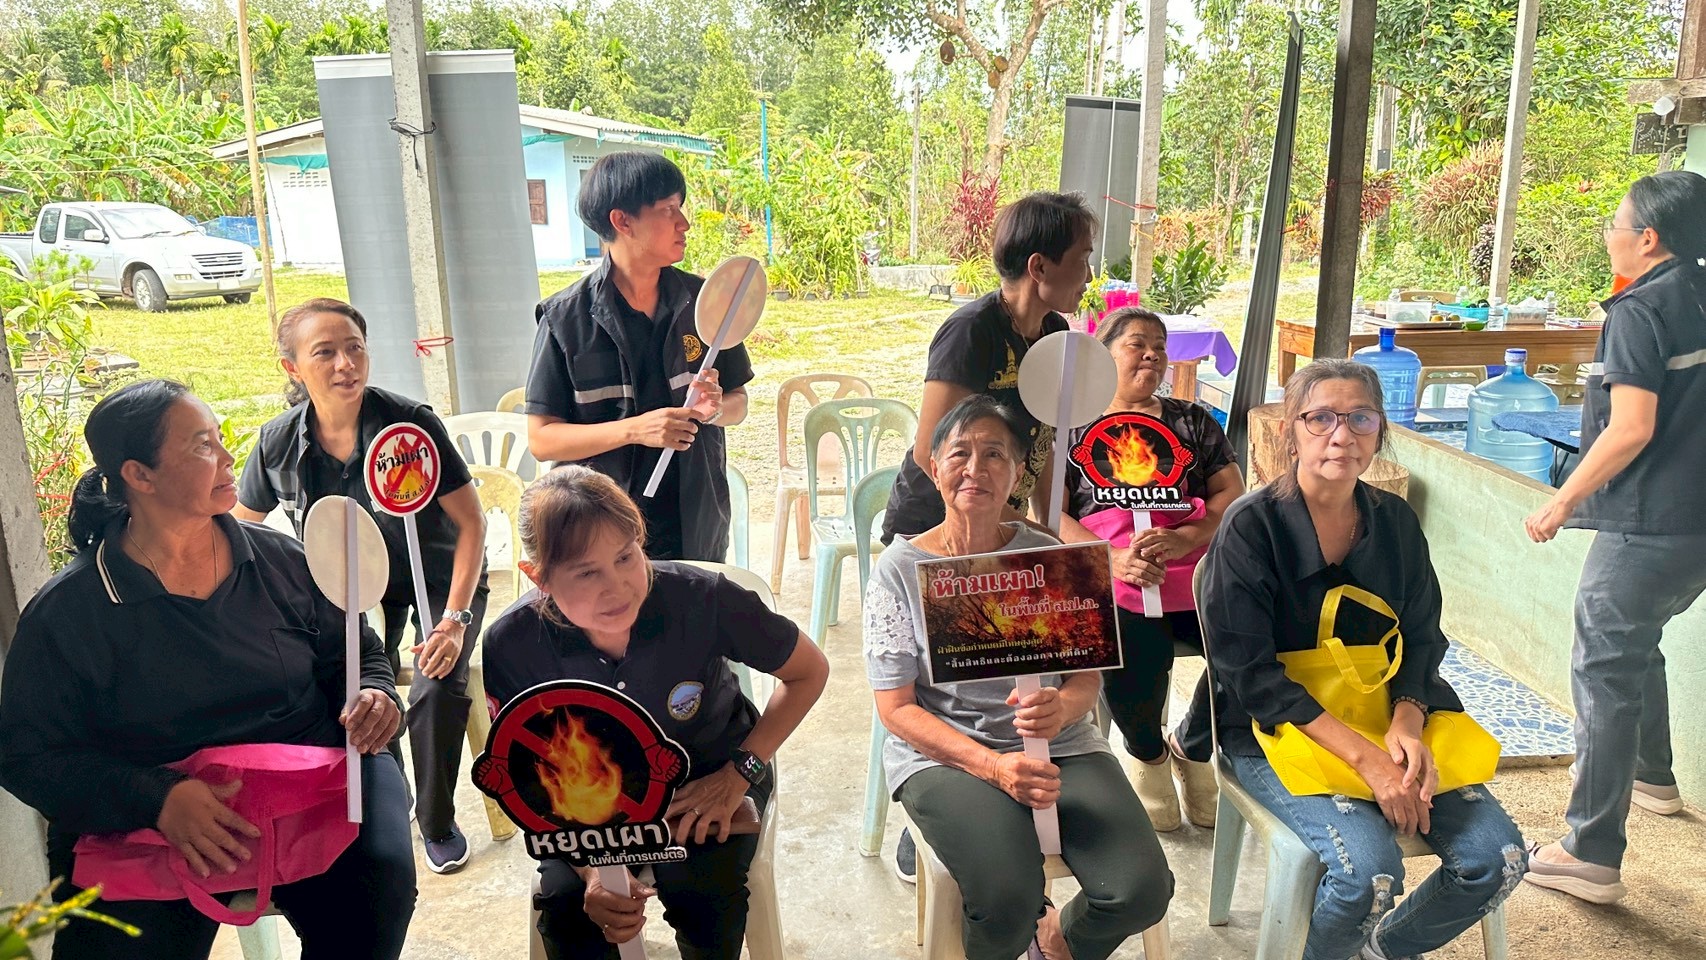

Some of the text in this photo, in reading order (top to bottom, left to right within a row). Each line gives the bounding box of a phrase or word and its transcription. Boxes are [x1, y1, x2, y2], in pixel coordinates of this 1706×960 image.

[375, 446, 429, 473] ห้ามเผา
[1097, 486, 1179, 505] หยุดเผา
[1131, 501, 1191, 510] ในพื้นที่การเกษตร
[932, 564, 1046, 599] ห้ามเผา!
[998, 594, 1100, 617] ในพื้นที่ ส.ป.ก.
[744, 755, 756, 769] 22
[530, 824, 664, 859] หยุดเผา
[588, 848, 685, 866] ในพื้นที่การเกษตร
